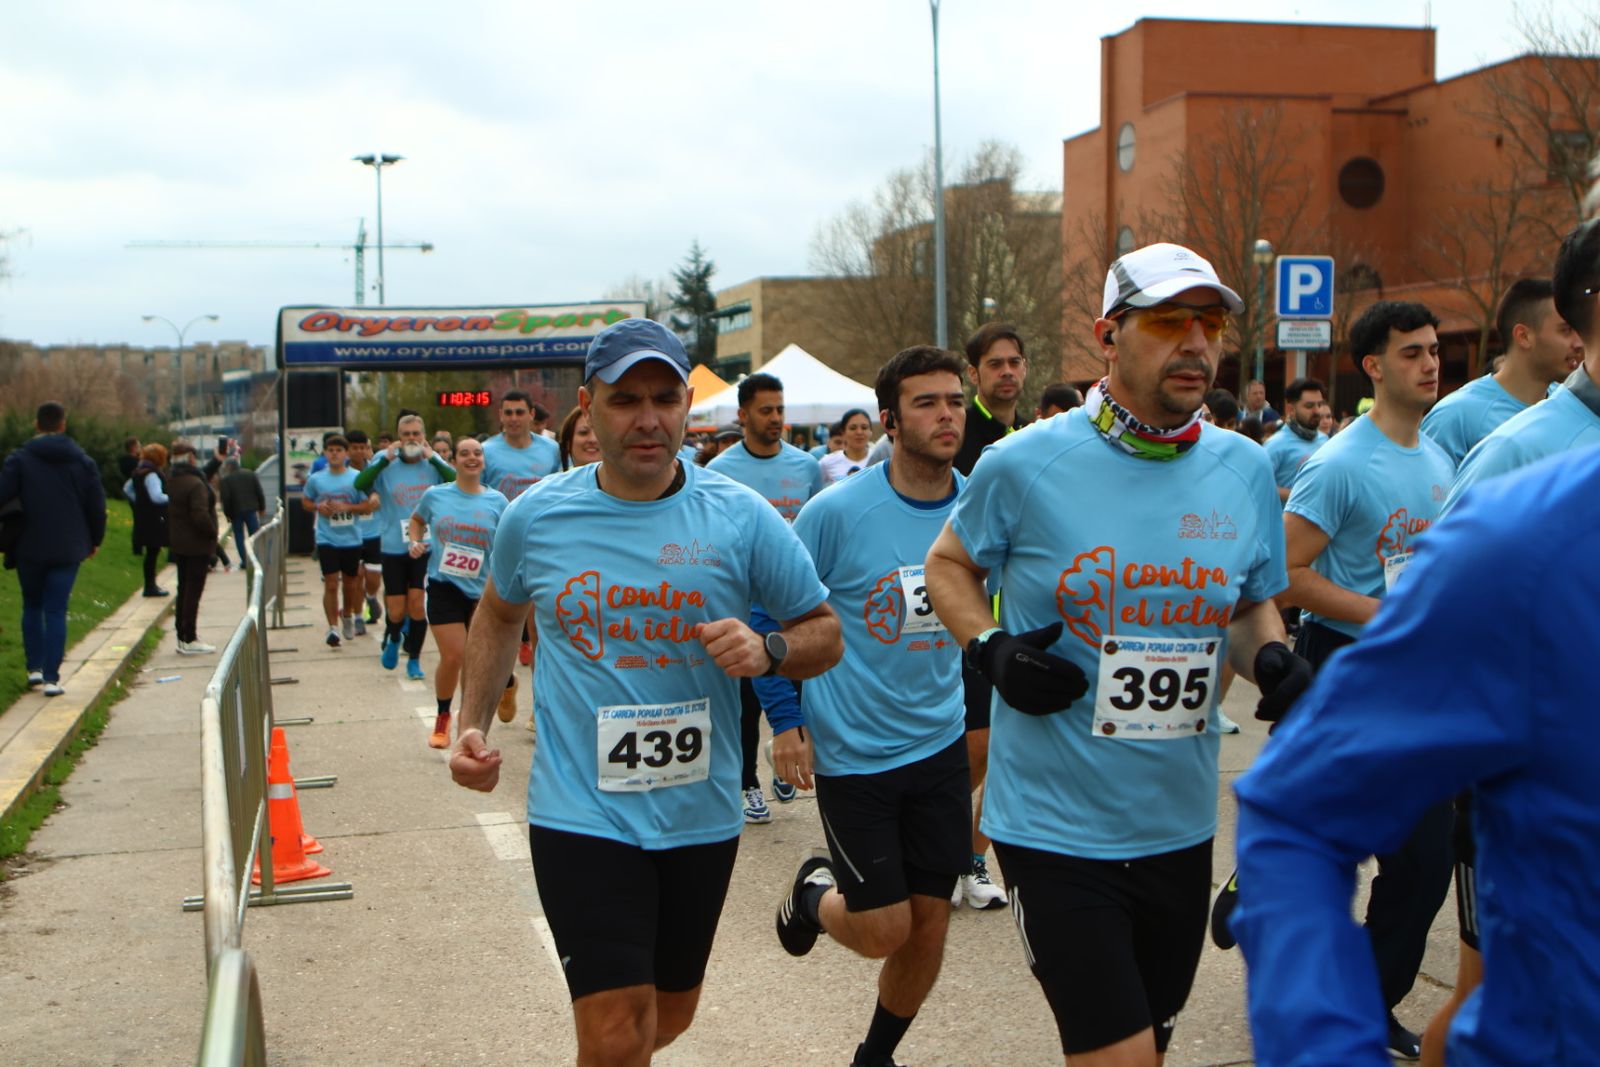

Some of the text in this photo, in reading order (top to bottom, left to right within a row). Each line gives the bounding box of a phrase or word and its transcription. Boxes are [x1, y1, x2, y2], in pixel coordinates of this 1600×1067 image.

[289, 264, 323, 310] P
[300, 308, 634, 337] OrycronSport
[441, 392, 490, 406] 11:02:15
[444, 552, 480, 571] 220
[1123, 556, 1228, 590] contra
[606, 580, 708, 611] contra
[1120, 595, 1232, 628] el ictus
[607, 615, 639, 642] el
[1109, 667, 1210, 712] 395
[608, 726, 703, 769] 439
